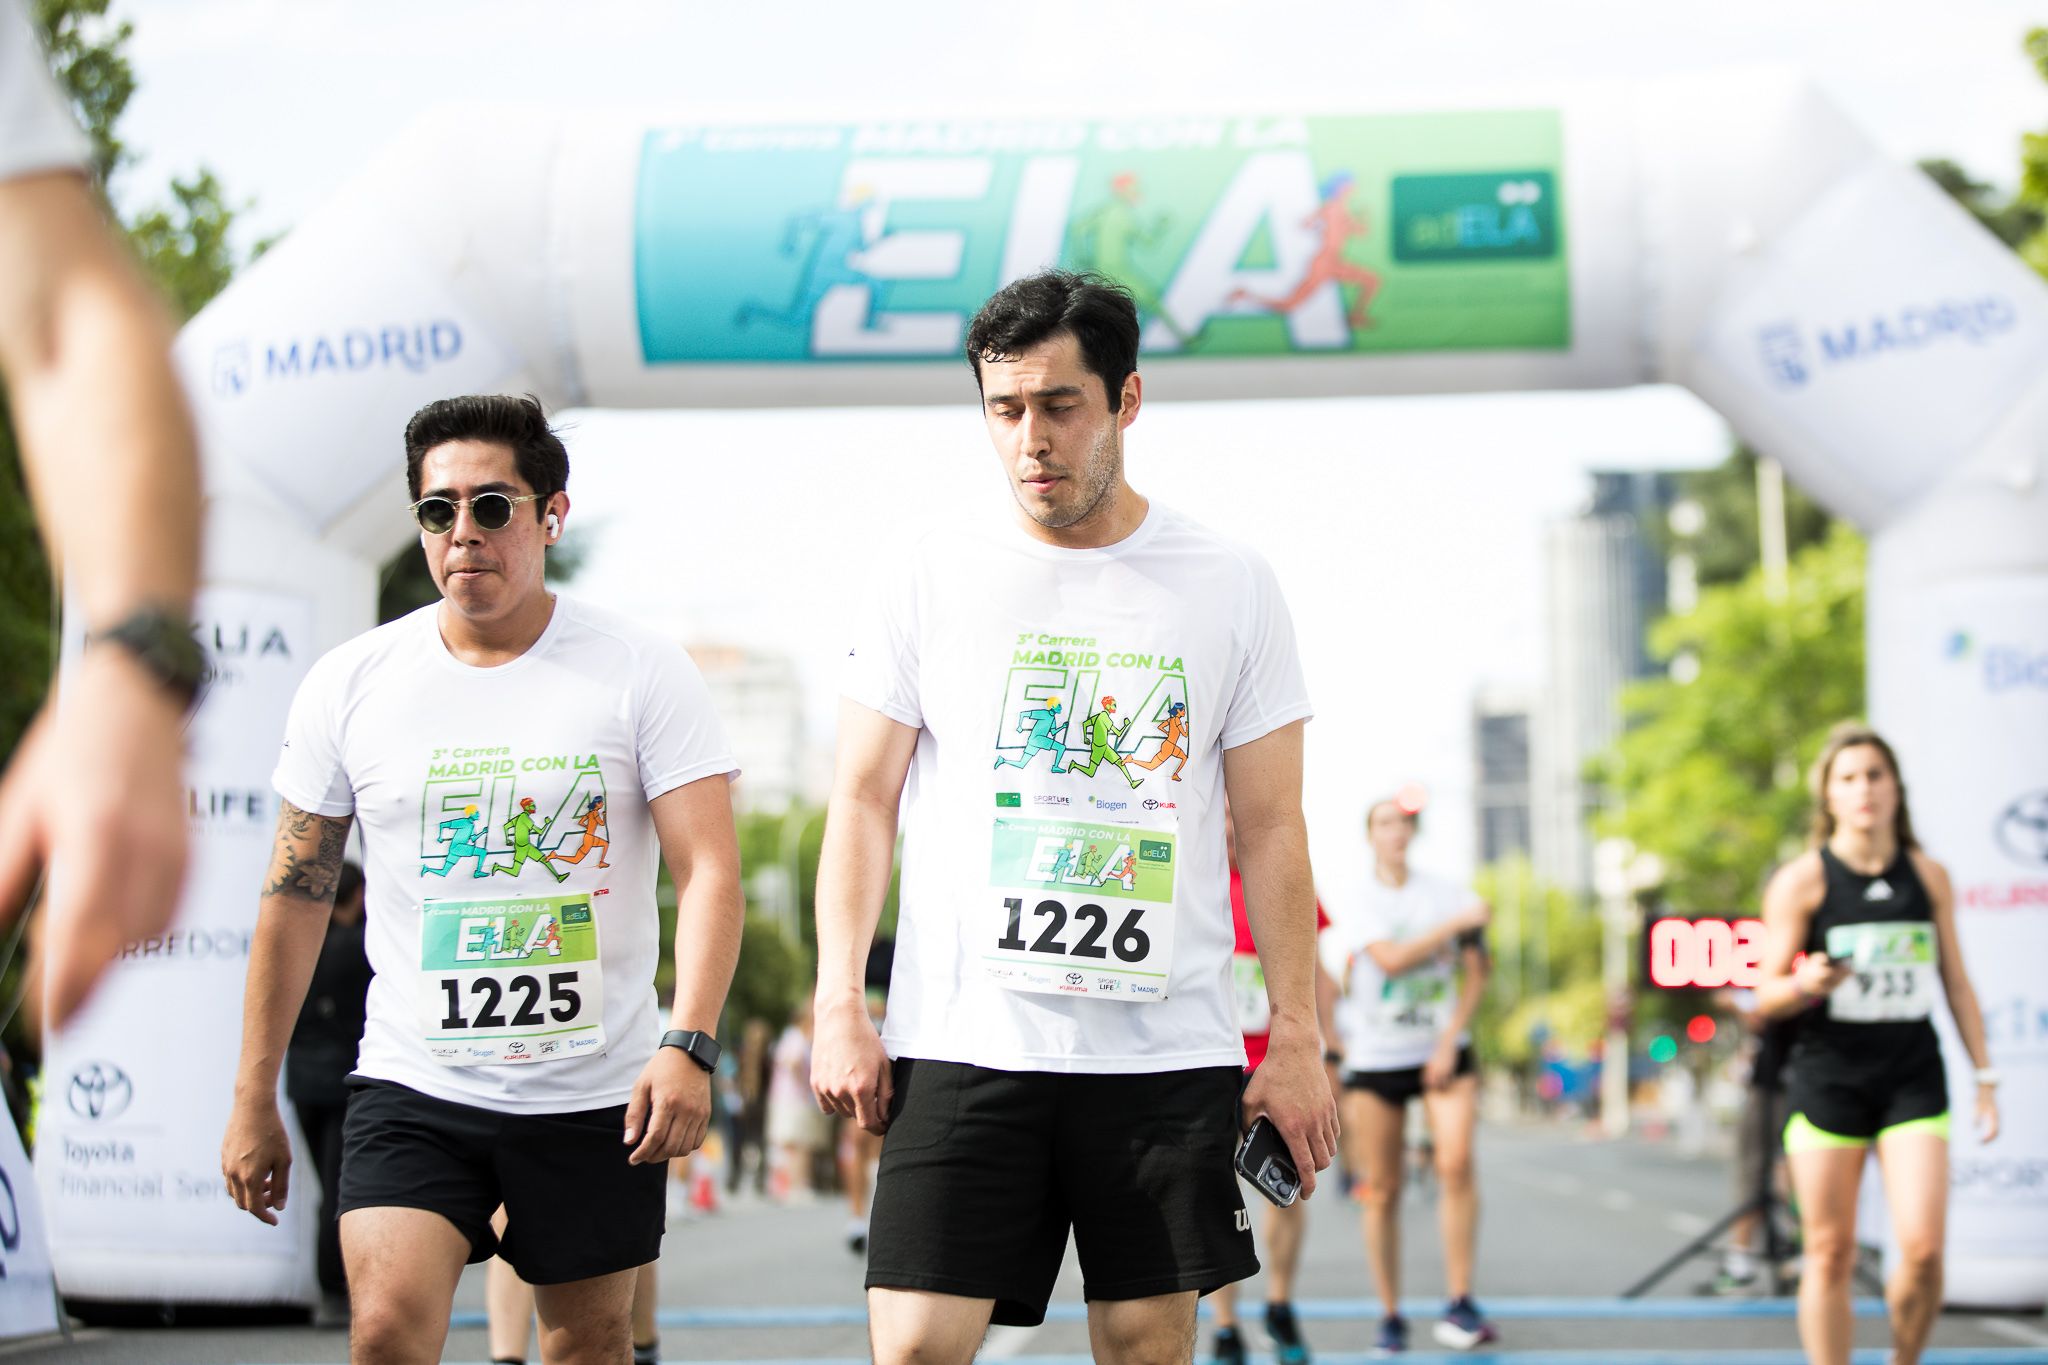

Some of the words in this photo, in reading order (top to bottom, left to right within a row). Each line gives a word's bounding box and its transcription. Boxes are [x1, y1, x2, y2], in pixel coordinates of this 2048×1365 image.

[812, 150, 1352, 356] ELA
[265, 319, 463, 375] MADRID
[1037, 634, 1097, 647] Carrera
[1012, 650, 1101, 668] MADRID
[1105, 653, 1153, 669] CON
[1158, 655, 1185, 673] LA
[996, 667, 1190, 759] ELA
[428, 759, 515, 778] MADRID
[520, 755, 568, 772] CON
[573, 753, 600, 769] LA
[452, 746, 511, 758] Carrera
[420, 770, 610, 859] ELA
[1096, 799, 1127, 812] Biogen
[1038, 824, 1086, 838] MADRID
[1088, 828, 1115, 841] CON
[1116, 831, 1131, 843] LA
[1024, 836, 1135, 892] ELA
[460, 905, 508, 916] MADRID
[508, 903, 534, 915] CON
[535, 902, 551, 912] LA
[455, 913, 562, 963] ELA
[997, 897, 1151, 963] 1226
[440, 970, 582, 1030] 1225
[1099, 983, 1115, 991] LIFE
[1137, 985, 1160, 994] MADRID
[62, 1137, 136, 1167] Toyota
